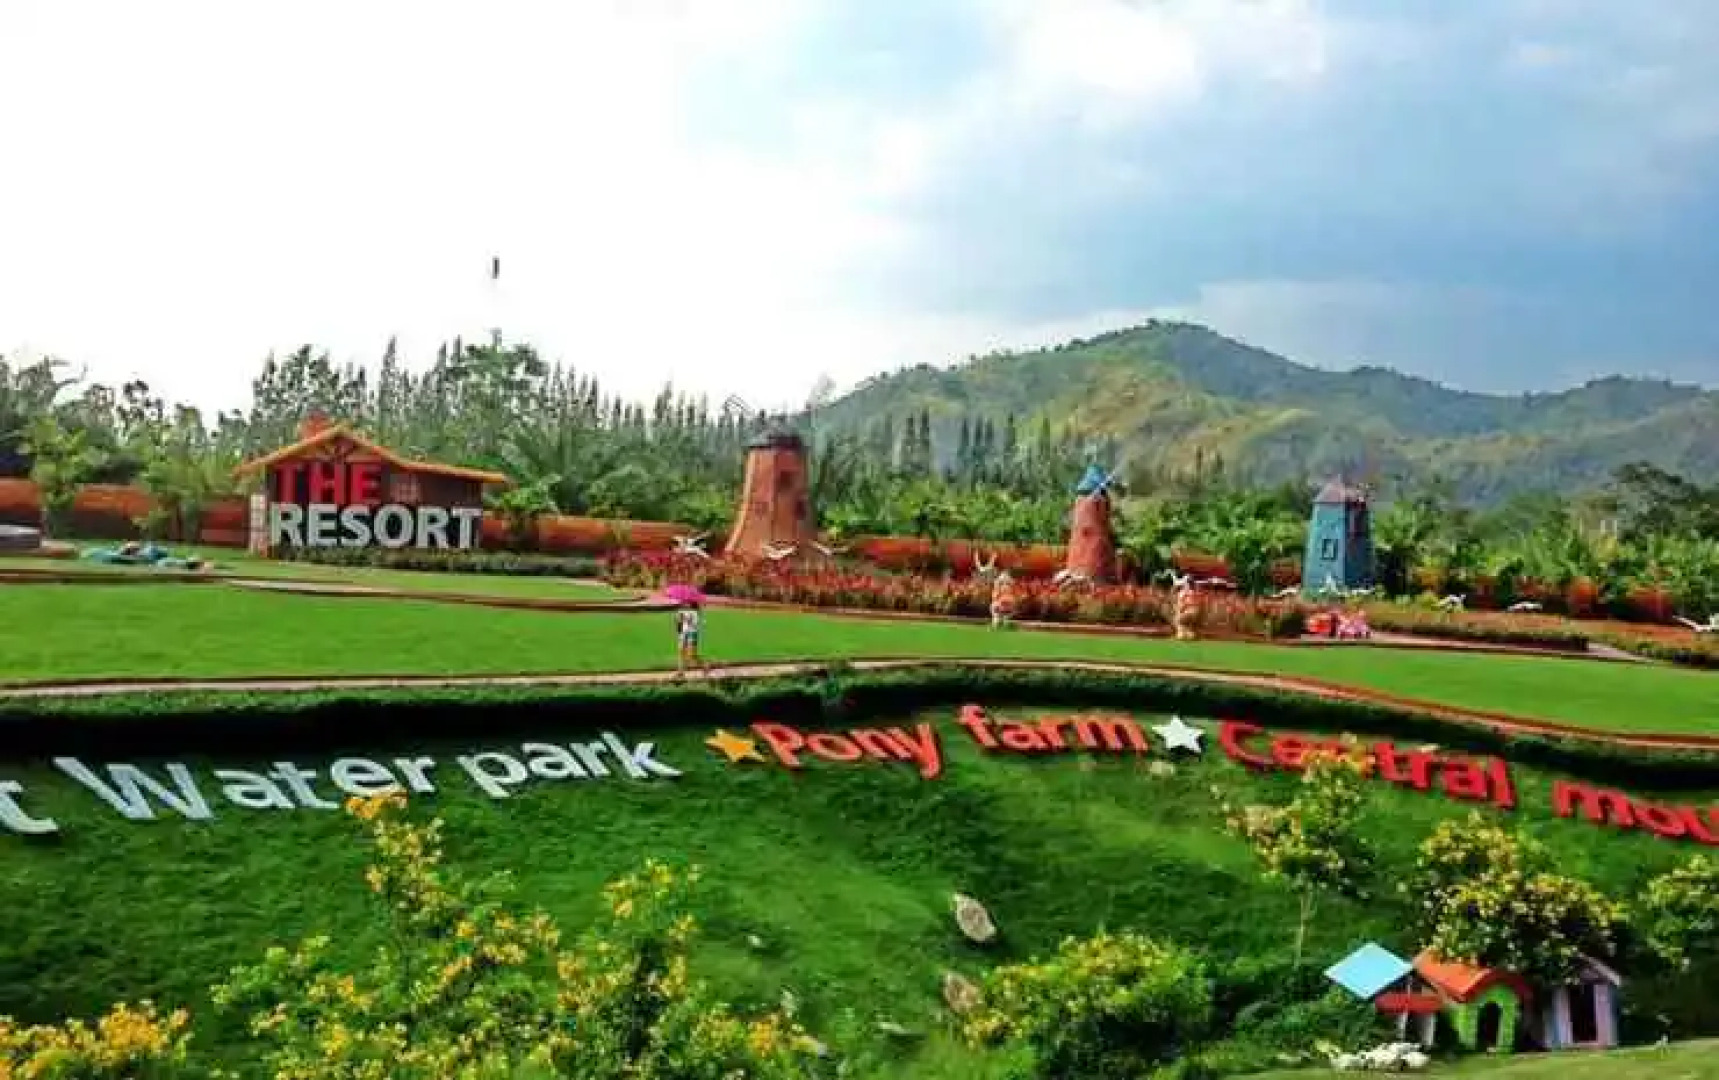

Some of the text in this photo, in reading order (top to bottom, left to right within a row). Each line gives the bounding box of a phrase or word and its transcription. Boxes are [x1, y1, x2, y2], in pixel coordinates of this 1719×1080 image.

[275, 460, 382, 502] THE
[270, 503, 483, 549] RESORT
[53, 755, 435, 820] Water
[456, 732, 682, 798] park
[752, 722, 941, 779] Pony
[958, 705, 1149, 752] farm
